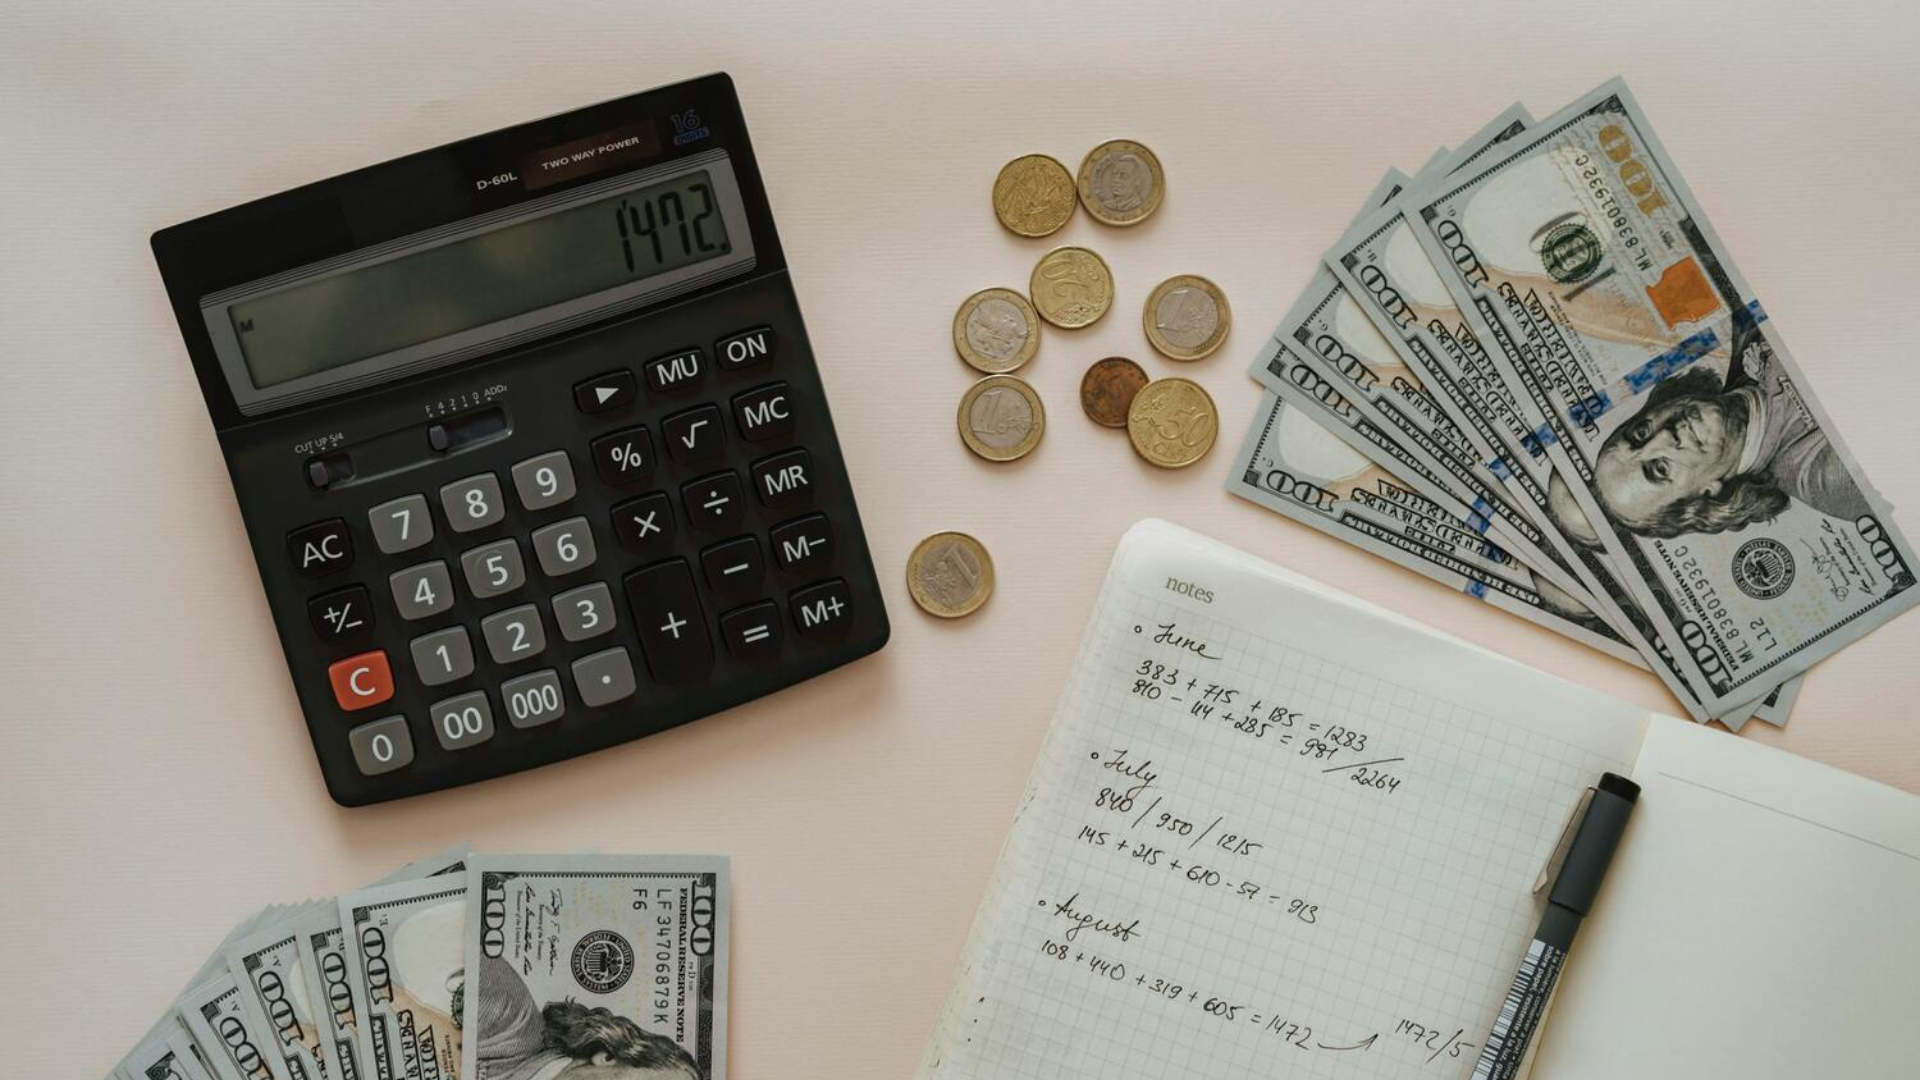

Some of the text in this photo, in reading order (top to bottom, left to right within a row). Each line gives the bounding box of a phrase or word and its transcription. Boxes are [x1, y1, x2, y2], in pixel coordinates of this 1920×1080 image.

[476, 172, 518, 191] D-60L
[541, 136, 640, 171] TWO WAY POWER
[1593, 121, 1666, 217] 100
[1574, 153, 1652, 270] ML 83801932 C
[1434, 218, 1488, 288] 100
[1358, 262, 1416, 328] 100
[1496, 281, 1553, 363] STATES
[238, 319, 255, 333] M
[1426, 317, 1491, 394] STATES
[657, 334, 766, 385] MU ON
[1287, 361, 1354, 417] 100
[1312, 332, 1378, 391] 100
[1408, 338, 1467, 408] DOLLARS
[744, 396, 788, 428] MC
[1157, 403, 1212, 450] 50
[1375, 398, 1444, 458] DOLLARS
[1389, 375, 1465, 444] STATES
[1522, 374, 1573, 448] HUNDRED
[1543, 359, 1601, 441] UNITED
[294, 440, 314, 454] CUT
[315, 437, 327, 449] UP
[1462, 404, 1519, 471] HUNDRED
[391, 467, 557, 540] 7 8 9
[765, 465, 807, 495] MR
[1263, 466, 1338, 513] 100
[1349, 486, 1435, 532] STATES
[1442, 454, 1509, 516] HUNDRED
[304, 534, 343, 567] AC
[1342, 513, 1432, 559] DOLLARS
[1654, 539, 1675, 569] NOTE
[1673, 544, 1689, 558] C
[1856, 516, 1902, 586] 100
[414, 533, 578, 605] 4 5 6
[1165, 576, 1214, 604] notes
[1430, 550, 1505, 591] HUNDRED
[1672, 569, 1708, 621] RESERVE
[1681, 557, 1739, 640] 83801932
[436, 599, 599, 672] 1 2 3
[802, 597, 844, 626] M+
[1153, 623, 1223, 660] June
[1749, 617, 1776, 650] L12
[1678, 619, 1732, 688] 100
[1703, 620, 1739, 671] FEDERAL
[1733, 640, 1754, 663] ML
[350, 667, 376, 696] C
[1135, 659, 1368, 752] 383 715 185 1283
[372, 684, 558, 762] 0 00 000
[1132, 678, 1162, 700] 810
[1299, 737, 1339, 761] 981
[1104, 749, 1157, 801] July
[1350, 767, 1401, 794] 2264
[1094, 788, 1263, 856] 840 950 1215
[632, 888, 648, 911] F6
[1077, 824, 1110, 846] 145
[1132, 843, 1165, 866] 215
[1186, 865, 1221, 887] 610
[1287, 898, 1319, 924] 913
[484, 886, 507, 959] 100
[691, 880, 716, 956] 100
[1053, 892, 1140, 943] August
[361, 926, 393, 1004] 100
[653, 888, 672, 1024] LF 34706879 K
[675, 887, 689, 1043] FEDERAL RESERVE NOTE
[1540, 945, 1554, 967] sobre
[258, 970, 302, 1045] 100
[320, 951, 357, 1030] 100
[1041, 939, 1070, 961] 108
[1202, 997, 1245, 1021] 605
[1265, 1014, 1312, 1051] 1472
